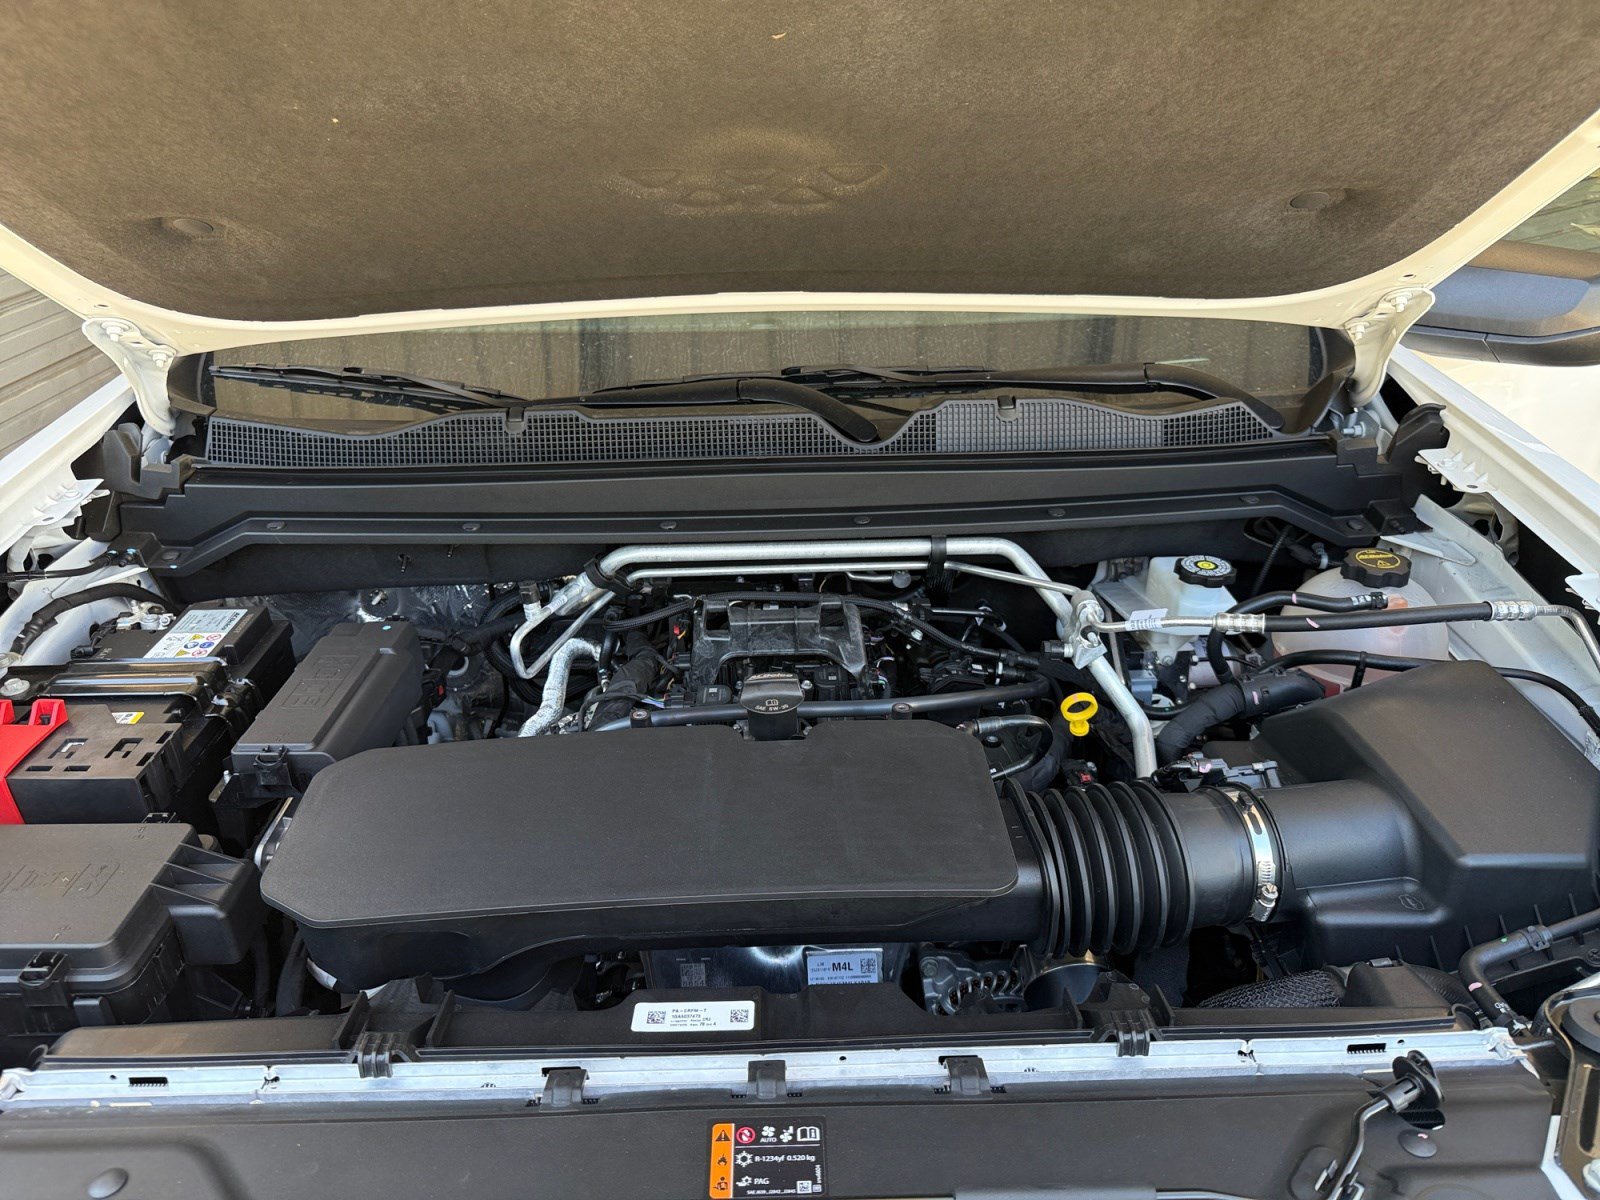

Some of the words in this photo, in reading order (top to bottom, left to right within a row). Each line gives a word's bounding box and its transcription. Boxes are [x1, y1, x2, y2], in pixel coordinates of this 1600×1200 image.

[832, 961, 854, 972] M4L
[754, 1154, 785, 1163] R-1234yf
[786, 1154, 806, 1162] 0.520
[805, 1154, 816, 1162] kg
[753, 1177, 770, 1185] PAG
